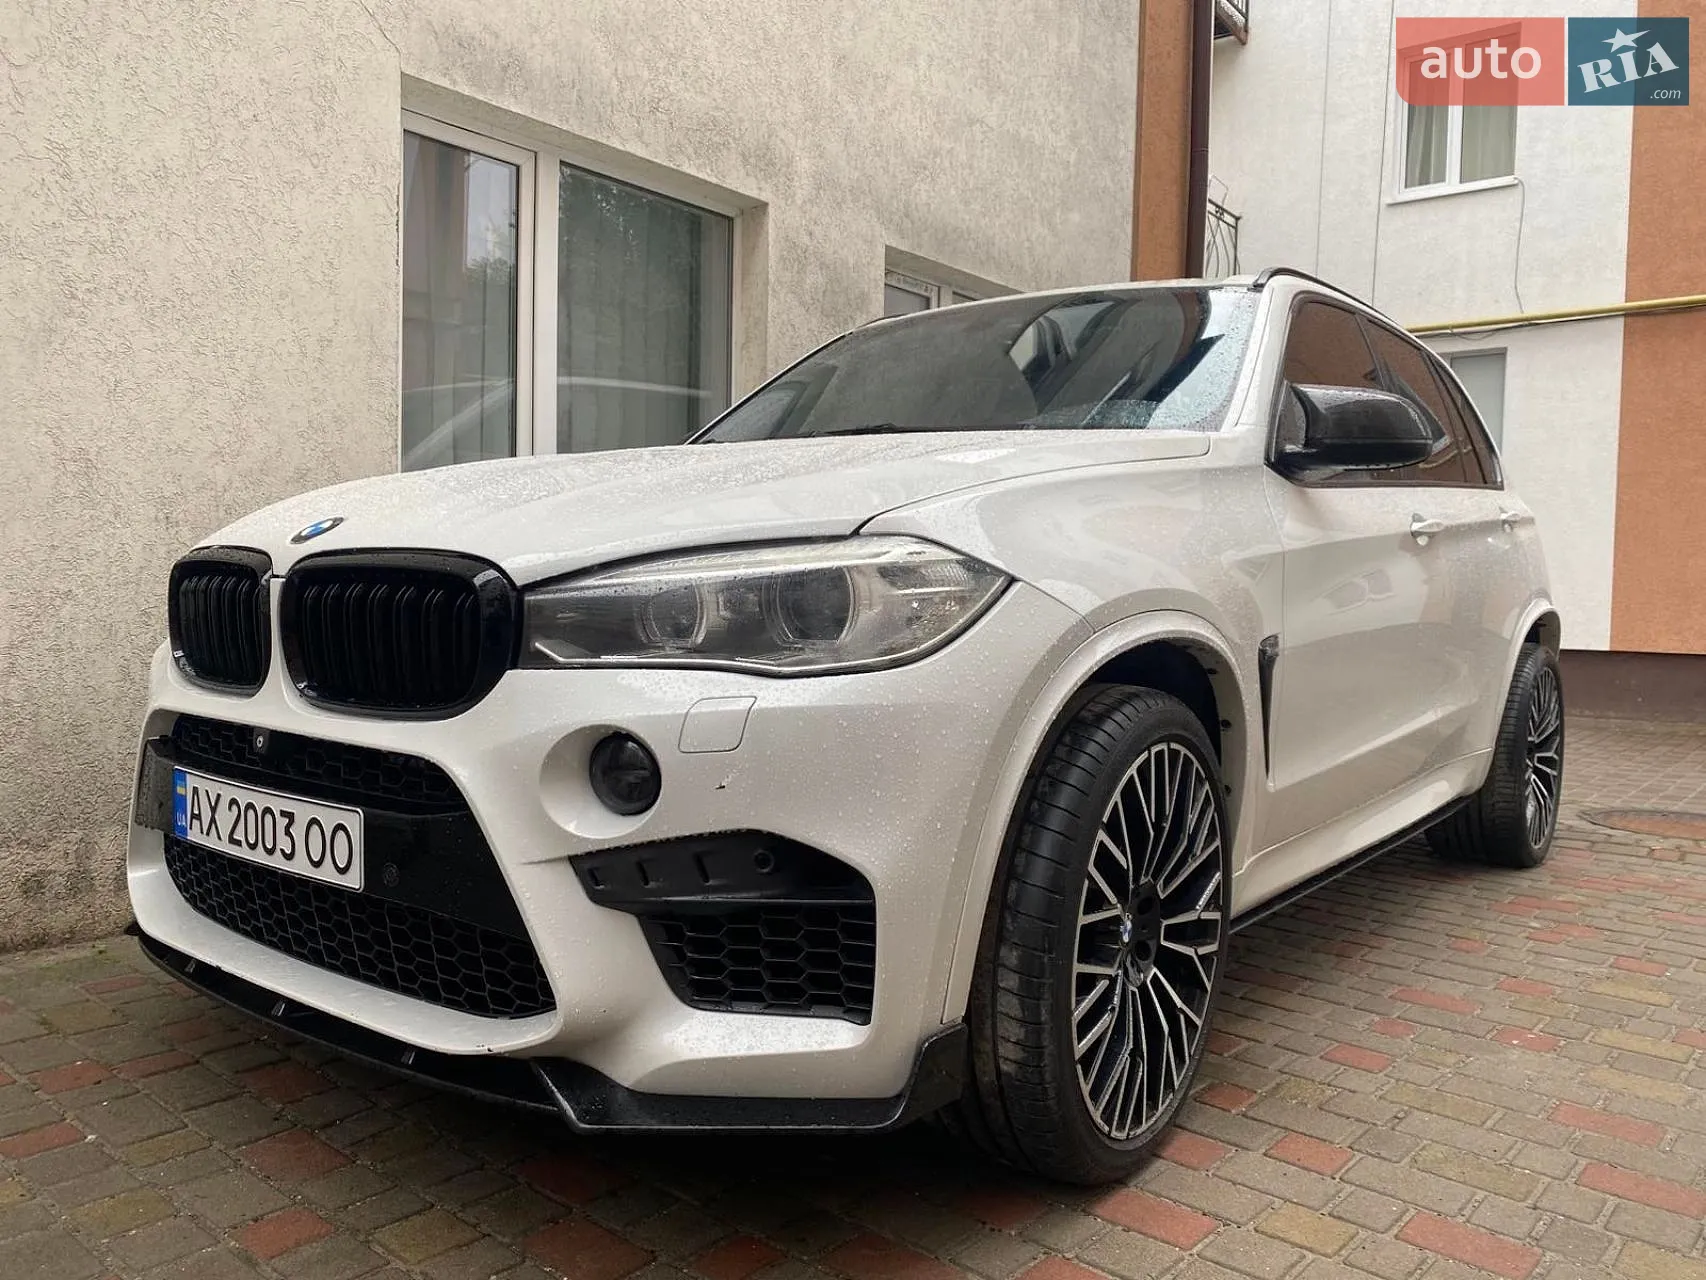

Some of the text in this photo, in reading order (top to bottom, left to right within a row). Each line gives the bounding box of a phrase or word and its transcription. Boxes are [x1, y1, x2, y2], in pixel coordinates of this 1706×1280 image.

[176, 811, 187, 828] UA
[189, 786, 353, 875] AX 2003 OO
